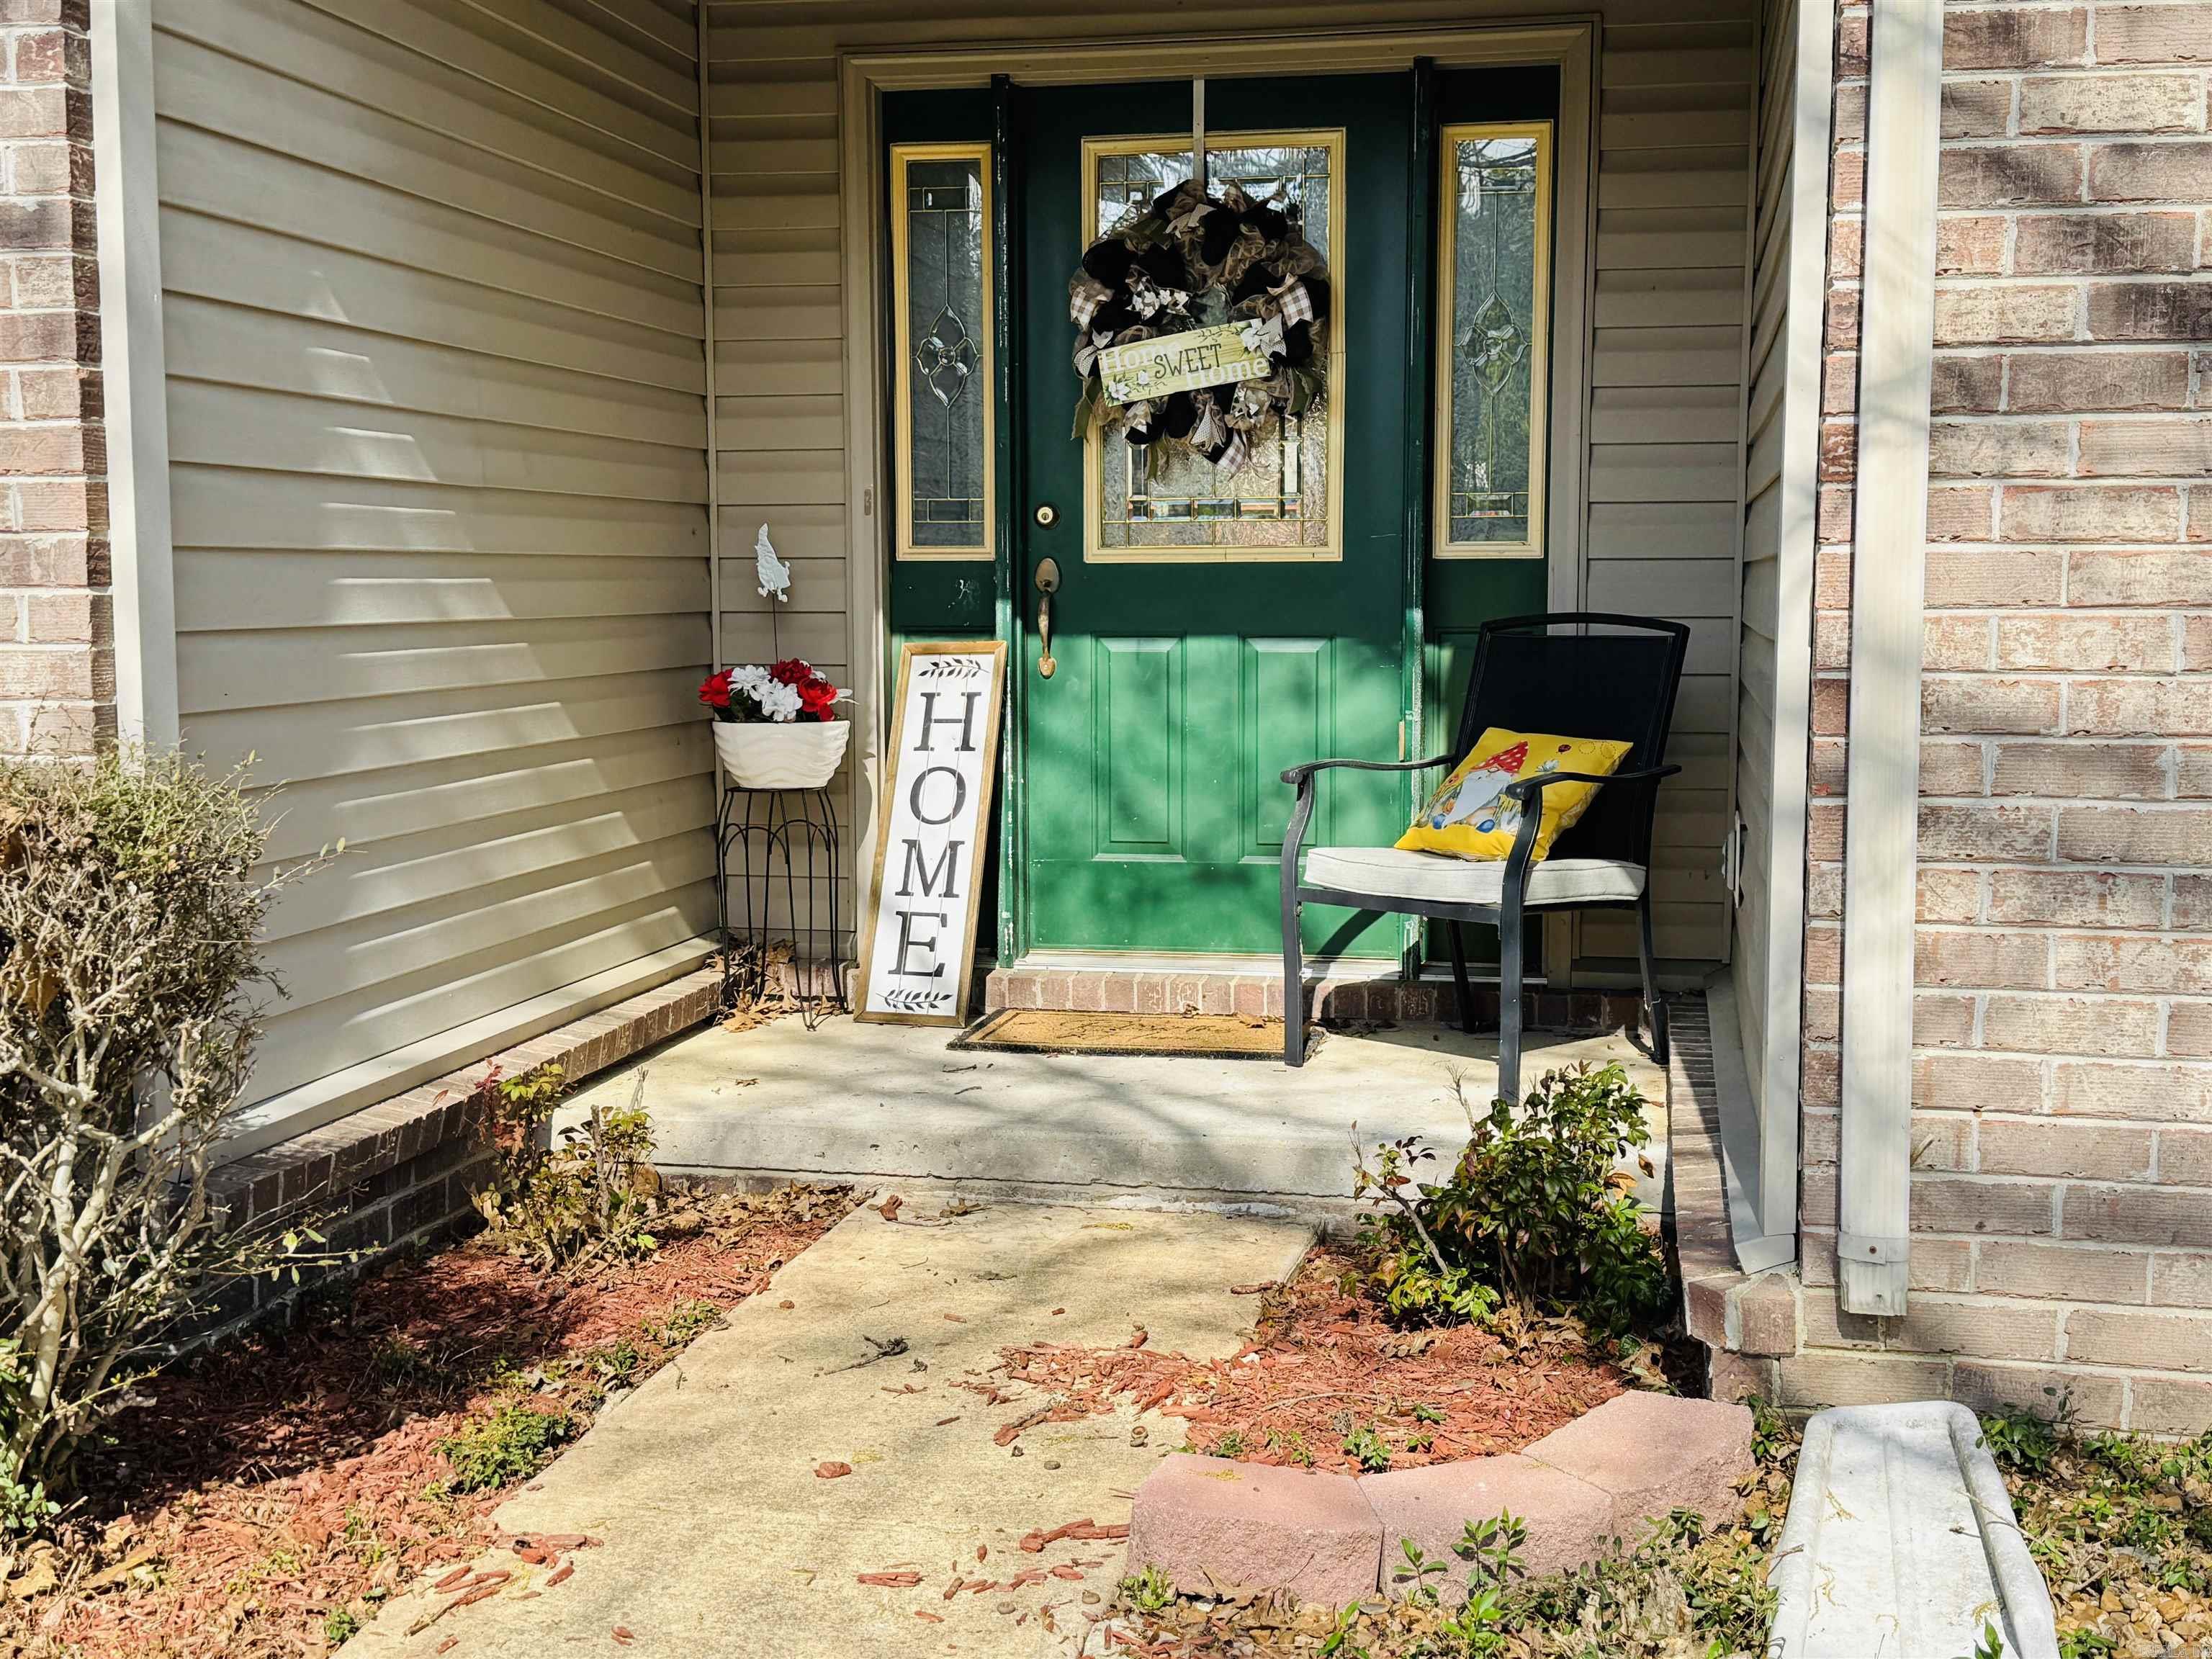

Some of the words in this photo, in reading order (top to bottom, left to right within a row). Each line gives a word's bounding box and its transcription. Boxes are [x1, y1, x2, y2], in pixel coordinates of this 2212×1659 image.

[1101, 340, 1182, 374] Home
[1154, 343, 1222, 379] SWEET
[1187, 357, 1269, 388] Home
[887, 691, 982, 978] HOME
